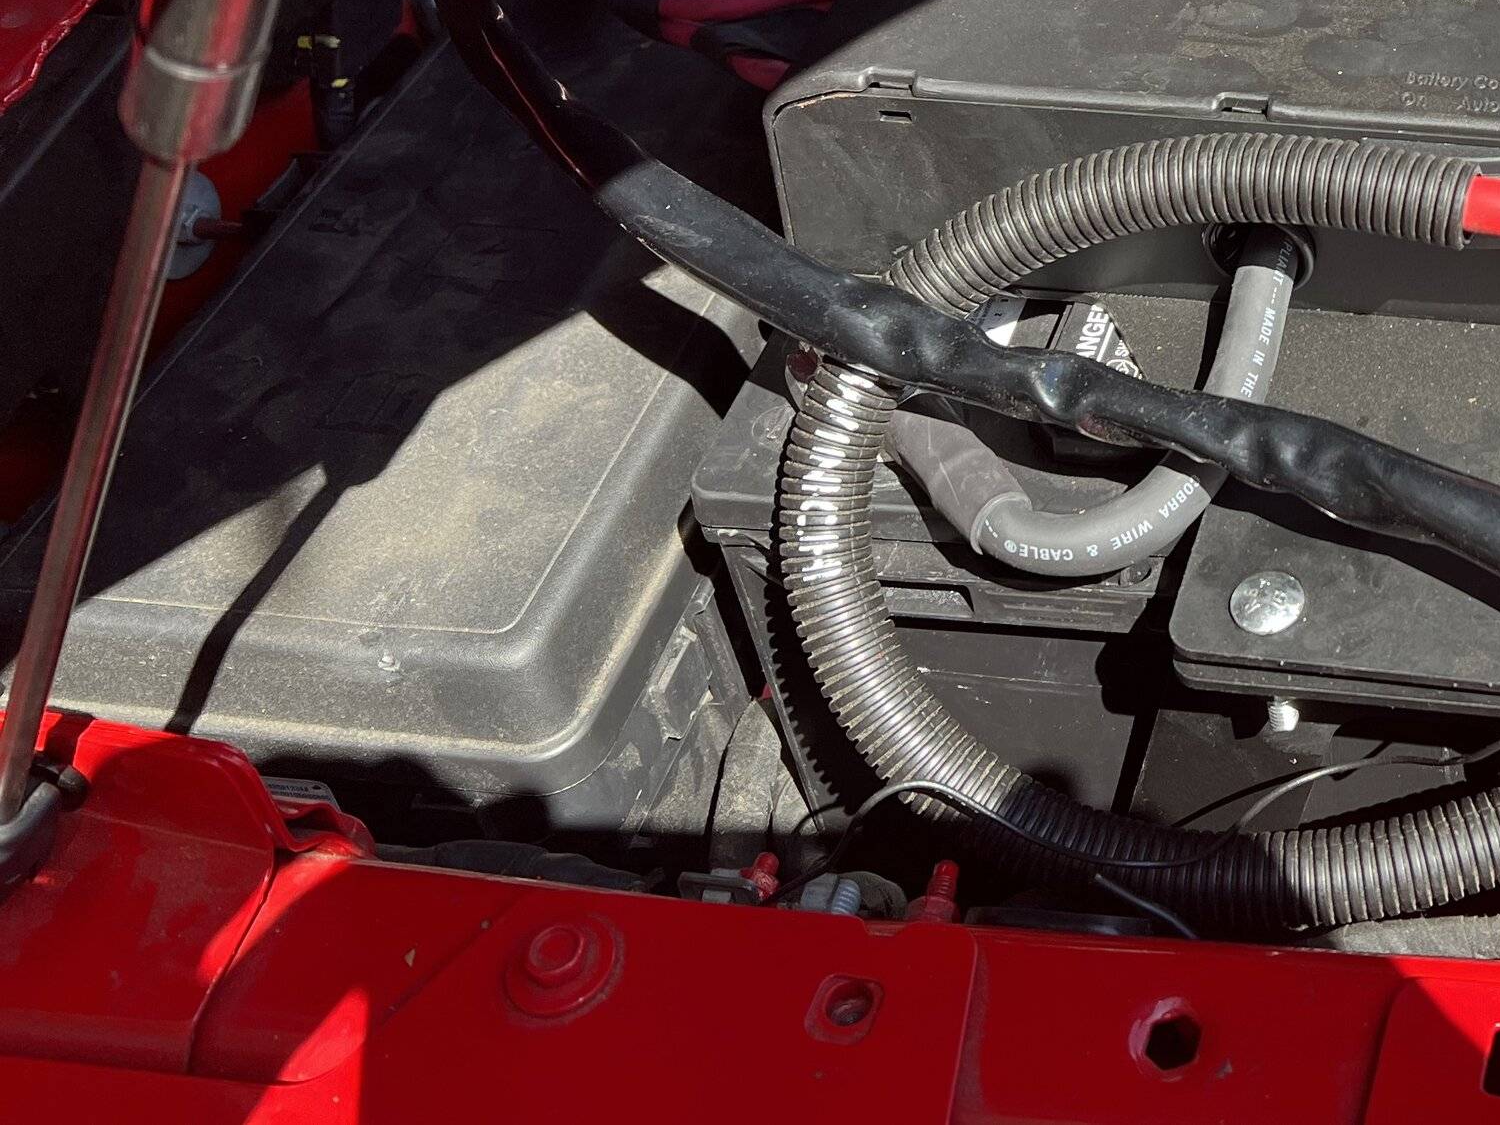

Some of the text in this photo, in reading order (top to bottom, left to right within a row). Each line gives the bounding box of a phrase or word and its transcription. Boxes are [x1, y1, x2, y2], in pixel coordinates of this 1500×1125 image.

[1405, 70, 1469, 91] Battery
[1455, 95, 1500, 113] Auto
[1258, 306, 1276, 346] MADE
[1252, 349, 1266, 366] IN
[1240, 371, 1258, 398] THE
[1158, 475, 1202, 519] COBRA
[1110, 519, 1154, 551] WIRE
[1086, 544, 1098, 557] &
